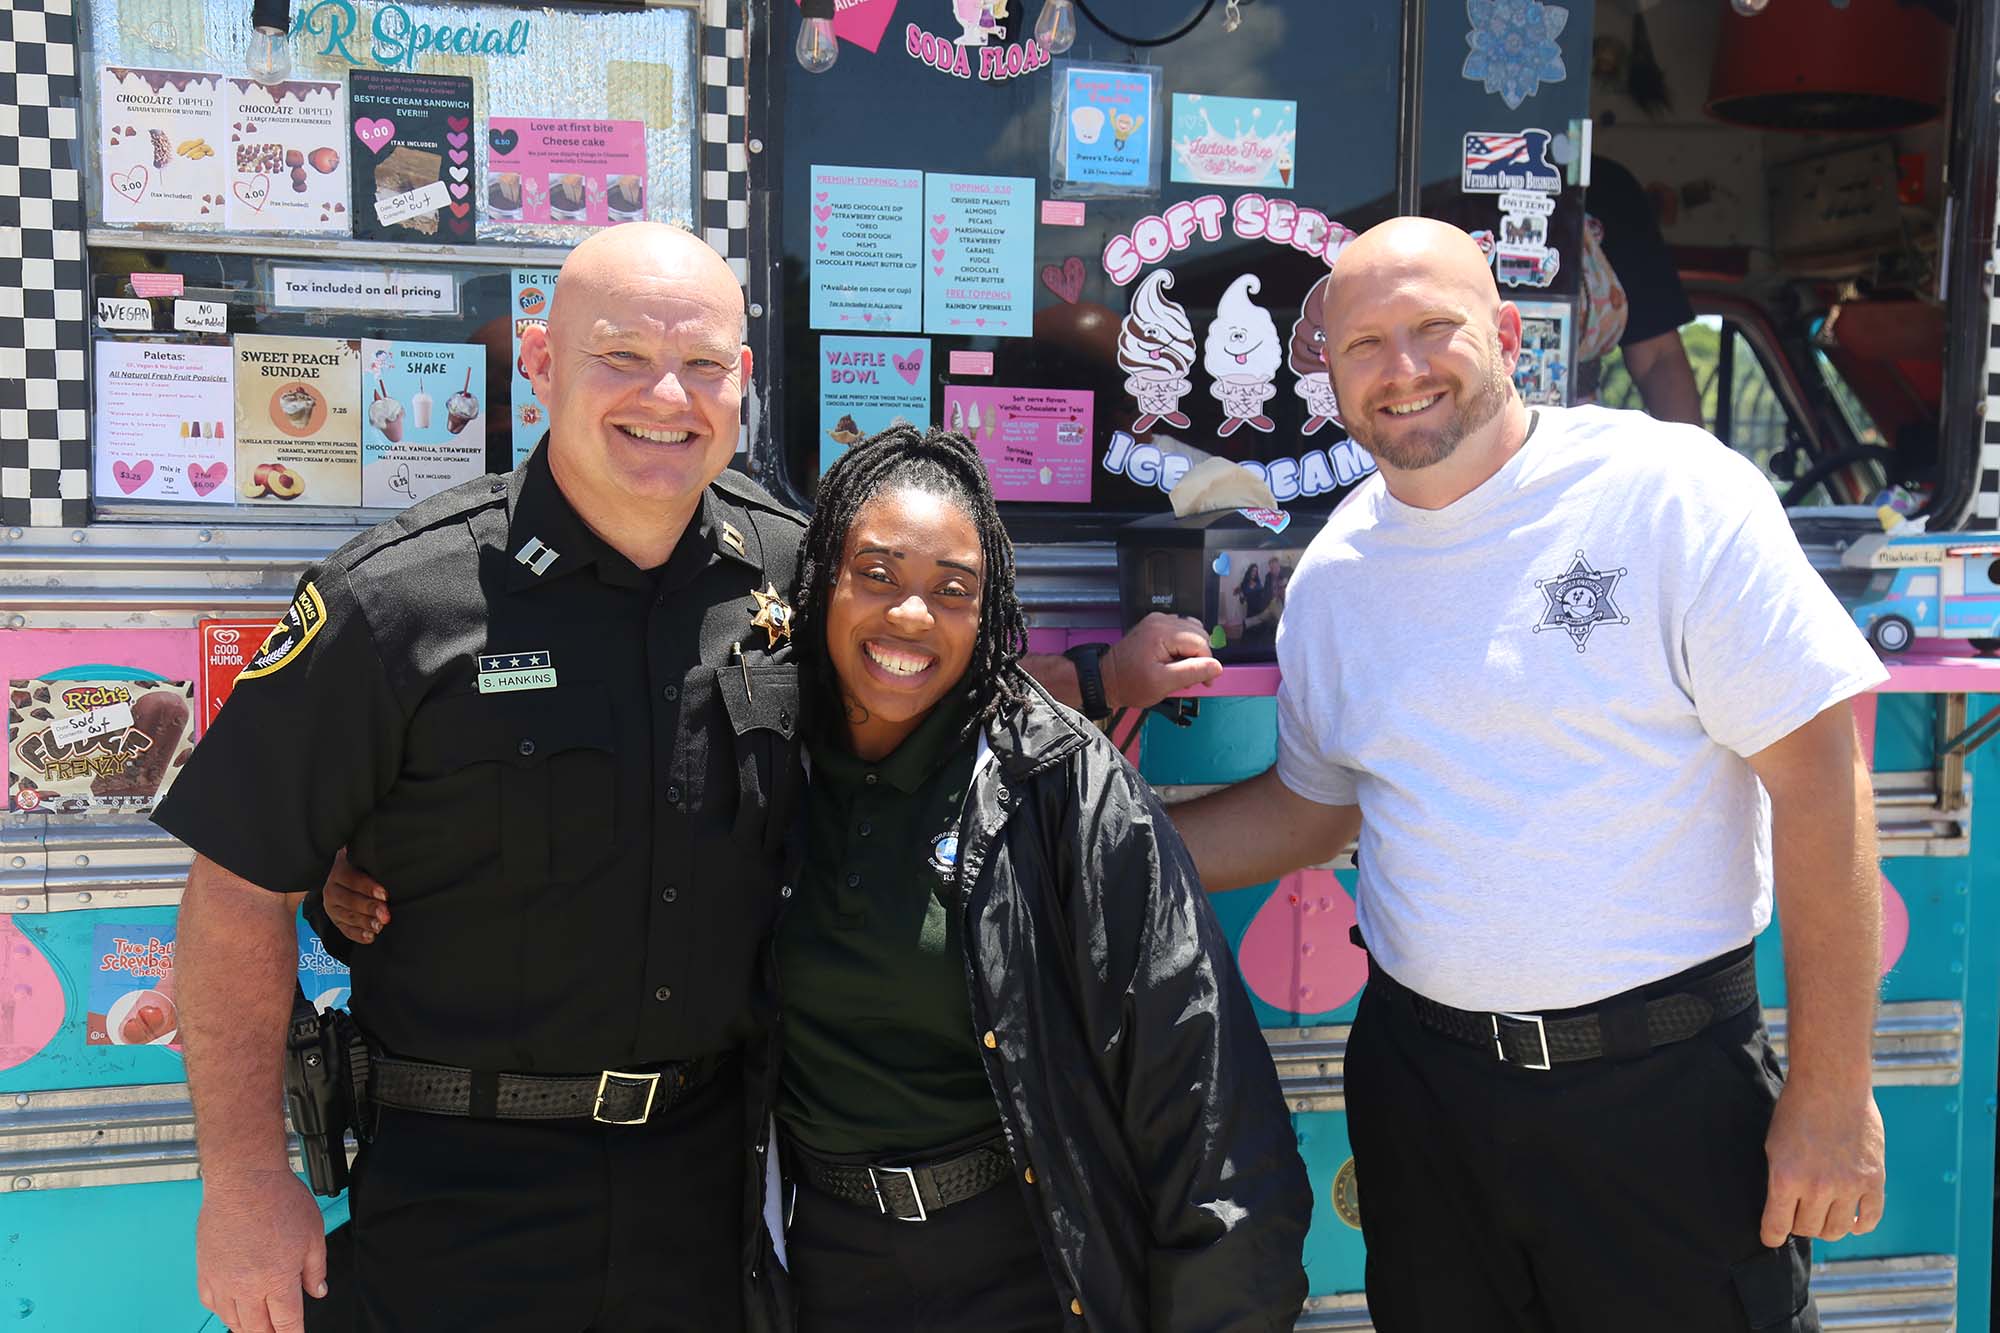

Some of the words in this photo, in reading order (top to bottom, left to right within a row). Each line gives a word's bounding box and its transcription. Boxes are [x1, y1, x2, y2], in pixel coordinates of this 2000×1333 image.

[371, 5, 529, 69] Special!
[907, 23, 970, 78] SODA
[116, 94, 173, 105] CHOCOLATE
[178, 98, 213, 107] DIPPED
[354, 94, 374, 103] BEST
[392, 98, 422, 106] CREAM
[424, 98, 470, 109] SANDWICH
[239, 104, 294, 115] CHOCOLATE
[298, 107, 332, 116] DIPPED
[396, 108, 429, 118] EVER!!!!
[362, 126, 388, 140] 6.00
[530, 122, 555, 131] Love
[558, 123, 568, 132] at
[570, 122, 590, 132] first
[594, 123, 613, 133] bite
[542, 136, 576, 146] Cheese
[582, 136, 605, 146] cake
[1190, 137, 1238, 159] Lactose
[1240, 141, 1273, 160] Free
[121, 181, 142, 192] 3.00
[1466, 170, 1497, 188] VETERAN
[1498, 170, 1525, 189] OWNED
[1526, 170, 1560, 190] BUSINESS
[244, 189, 264, 199] 4.00
[392, 191, 414, 208] Sold
[410, 192, 430, 210] out
[1503, 199, 1551, 210] PATIENT
[1104, 194, 1226, 284] SOFT
[1232, 193, 1360, 268] SERV
[519, 274, 538, 284] BIG
[286, 282, 308, 294] Tax
[311, 282, 362, 295] included
[366, 286, 381, 295] on
[384, 284, 398, 296] all
[401, 285, 442, 300] pricing
[946, 289, 966, 298] FREE
[108, 304, 150, 320] VEGAN
[198, 304, 212, 314] NO
[144, 350, 186, 361] Paletas:
[241, 350, 289, 364] SWEET
[292, 353, 339, 366] PEACH
[400, 350, 434, 358] BLENDED
[826, 350, 886, 367] WAFFLE
[261, 365, 320, 379] SUNDAE
[407, 362, 447, 374] SHAKE
[898, 362, 921, 370] 6.00
[121, 371, 150, 380] Natural
[152, 372, 172, 380] Fresh
[174, 373, 190, 381] Fruit
[192, 374, 227, 383] Popsicles
[831, 368, 880, 384] BOWL
[1103, 431, 1192, 493] ICE
[1236, 439, 1376, 501] EAM
[120, 471, 141, 481] $3.25
[214, 644, 239, 655] GOOD
[210, 656, 243, 665] HUMOR
[483, 679, 495, 688] S.
[498, 674, 551, 686] HANKINS
[65, 686, 130, 713] Rich's
[69, 712, 94, 729] Sold
[88, 717, 110, 734] out
[44, 752, 131, 782] FRENZY
